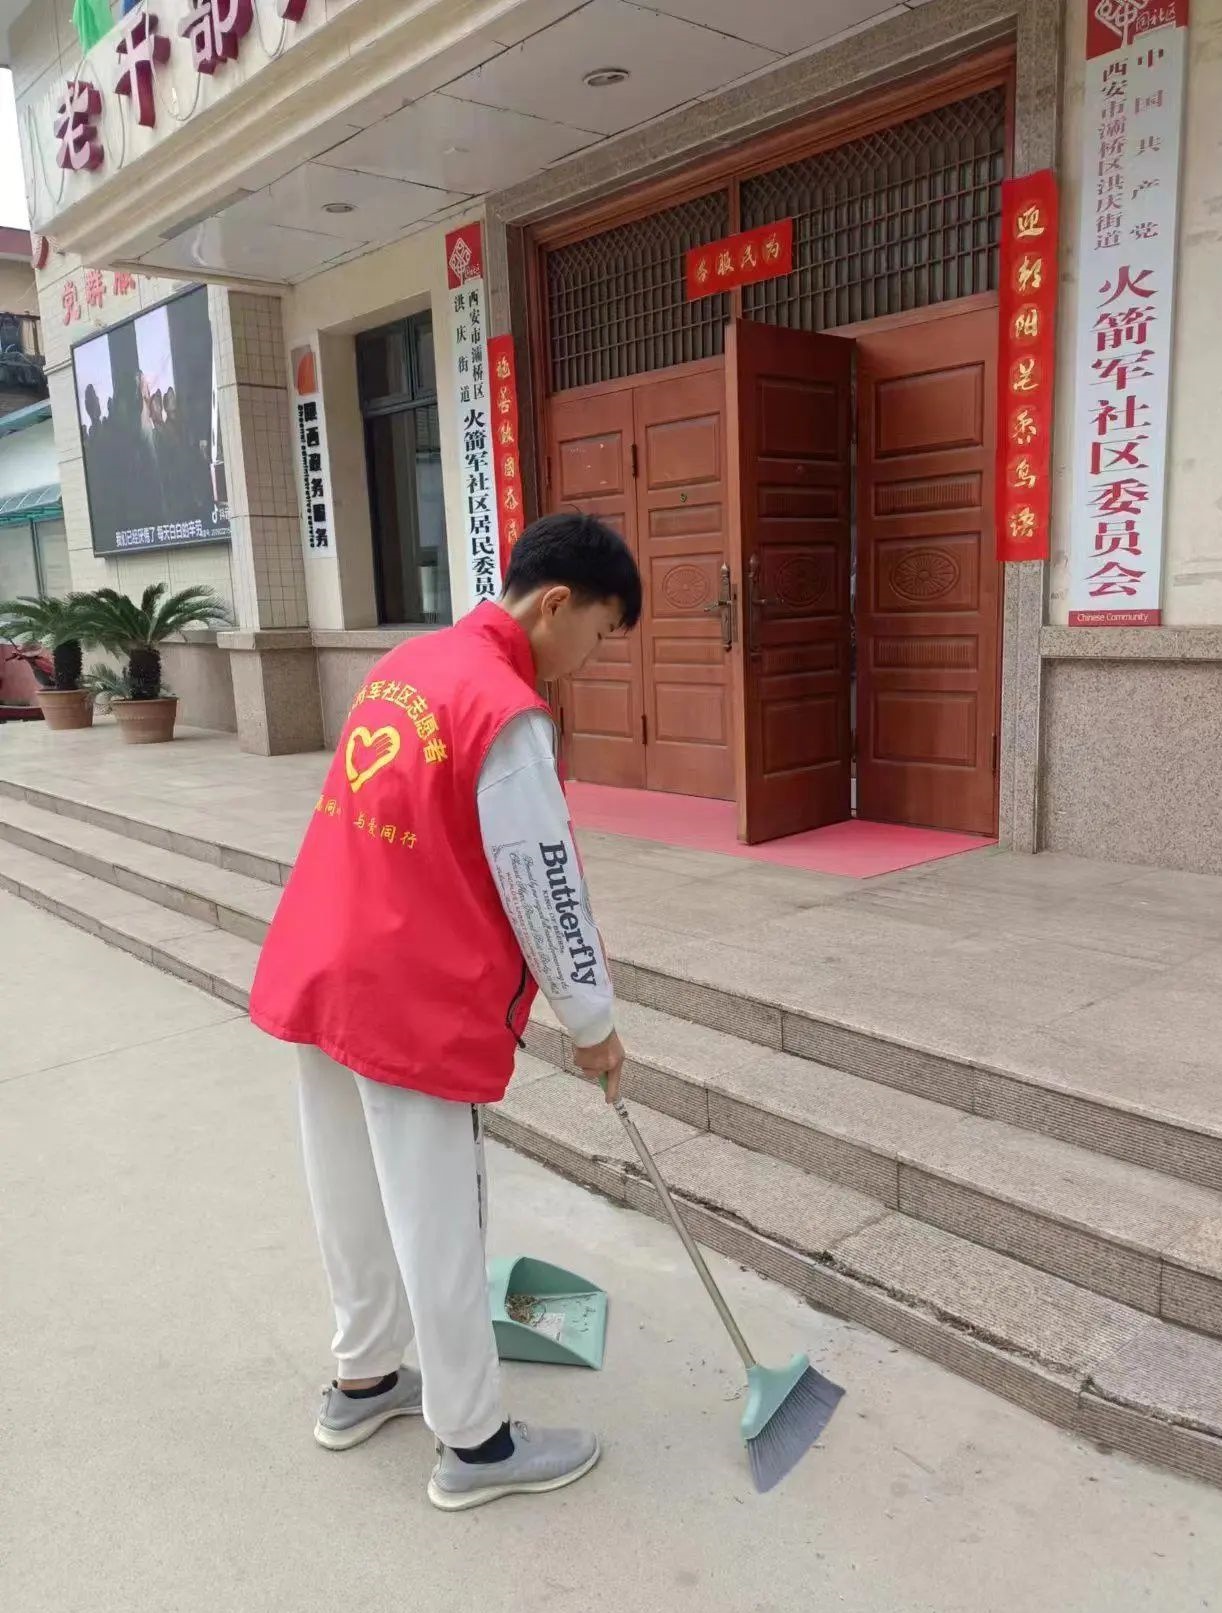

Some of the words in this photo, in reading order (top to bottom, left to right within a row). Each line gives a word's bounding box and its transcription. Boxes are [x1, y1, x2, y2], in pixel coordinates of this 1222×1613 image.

[54, 0, 308, 170] 老干部
[1130, 48, 1164, 241] 中国共产党
[454, 293, 471, 403] 洪庆街道
[468, 287, 485, 401] 西安市灞桥区
[463, 409, 497, 606] 火箭军社区居民委员
[1083, 265, 1158, 597] 火箭军社区委员会
[1076, 612, 1105, 623] Chinese
[1106, 611, 1149, 623] Community
[538, 840, 597, 987] Butterfly
